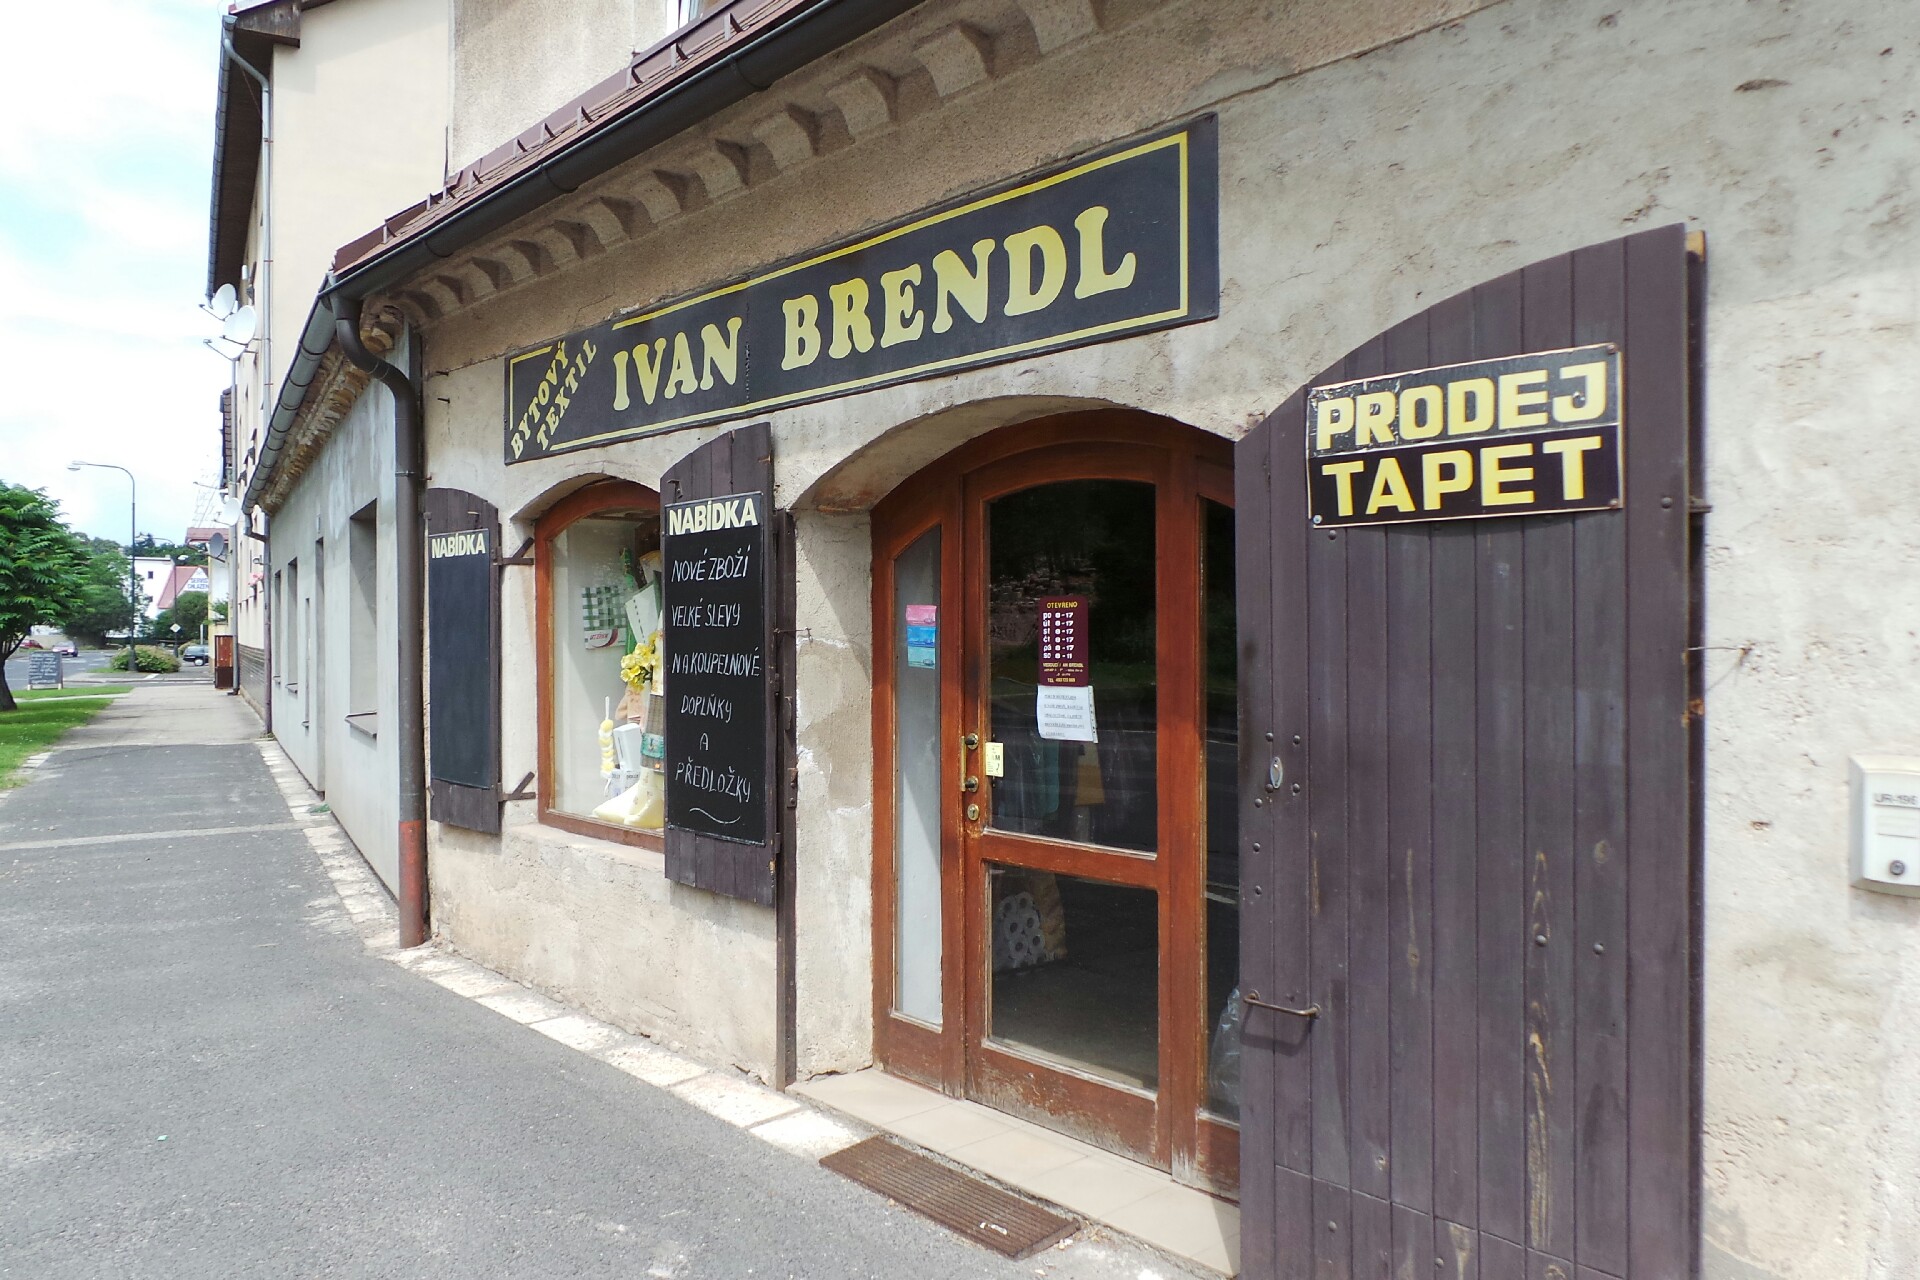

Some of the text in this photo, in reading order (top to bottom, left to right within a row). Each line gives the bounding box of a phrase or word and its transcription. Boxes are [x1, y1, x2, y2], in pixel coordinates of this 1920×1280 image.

[612, 205, 1137, 411] IVAN BRENDL
[511, 340, 568, 459] BYTOVÝ
[537, 339, 597, 450] TEXTIL
[1316, 361, 1608, 450] PRODEJ
[1321, 435, 1602, 517] TAPET
[669, 498, 758, 535] NABÍDKA
[431, 532, 486, 559] NABÍDKA
[671, 544, 751, 582] NOVÉ ZBOŽÍ
[671, 598, 741, 629] VELKÉ SLEVY
[680, 693, 732, 723] DOPLŇKY
[699, 732, 709, 751] A
[675, 756, 751, 803] PŘEDLOŽKY
